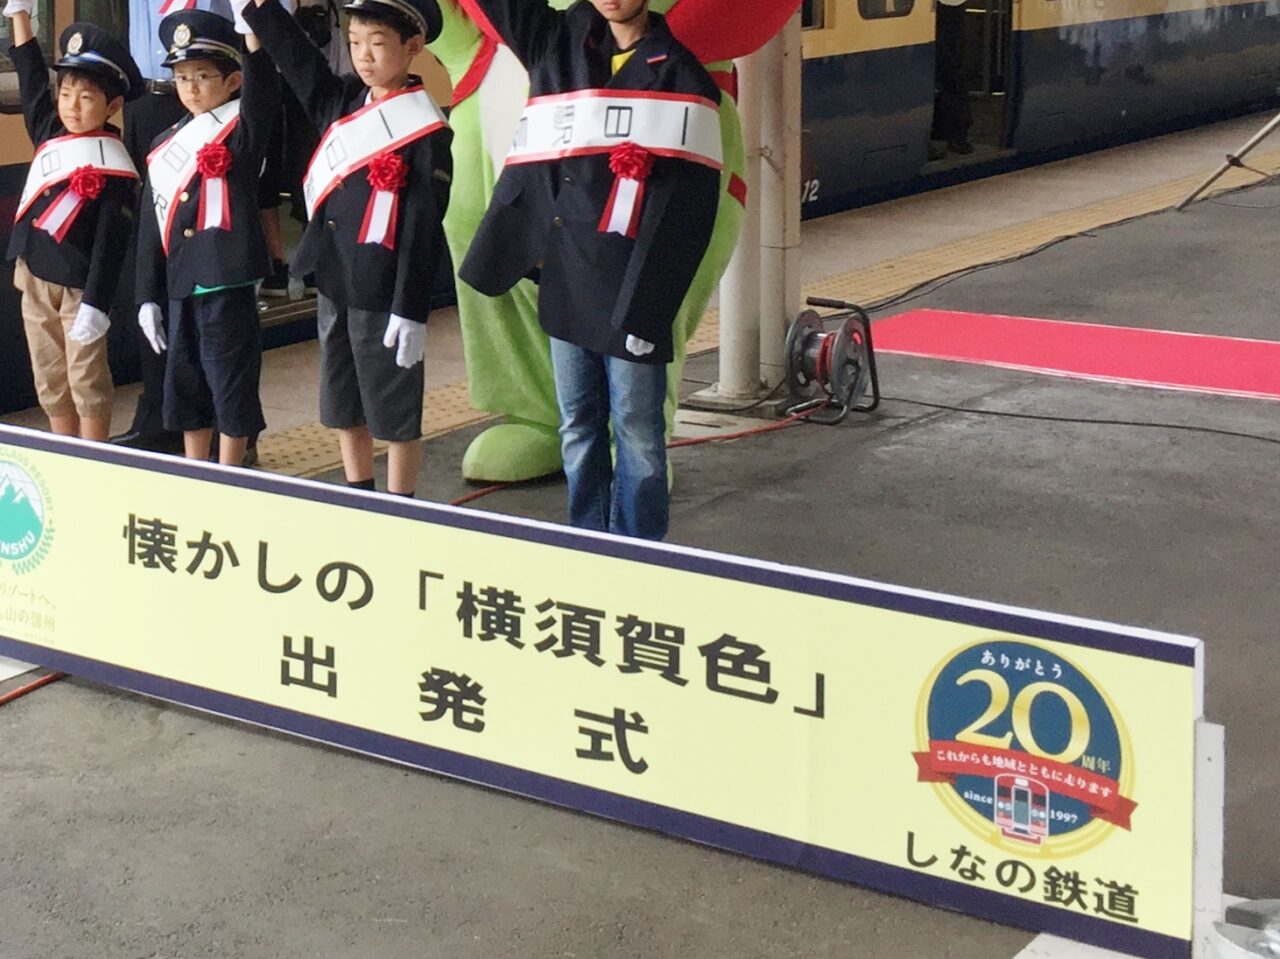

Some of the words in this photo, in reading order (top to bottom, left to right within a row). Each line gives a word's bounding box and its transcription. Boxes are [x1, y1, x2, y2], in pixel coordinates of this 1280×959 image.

[122, 512, 825, 720] 懐かしの「横須賀色」
[980, 649, 1063, 679] ありがとう
[280, 634, 650, 776] 出発式
[954, 667, 1091, 765] 20
[935, 748, 1113, 799] これからも地域とともに走ります
[1081, 754, 1112, 774] 周年
[963, 789, 993, 806] since
[1049, 808, 1078, 825] 1997
[906, 830, 1140, 924] しなの鉄道
